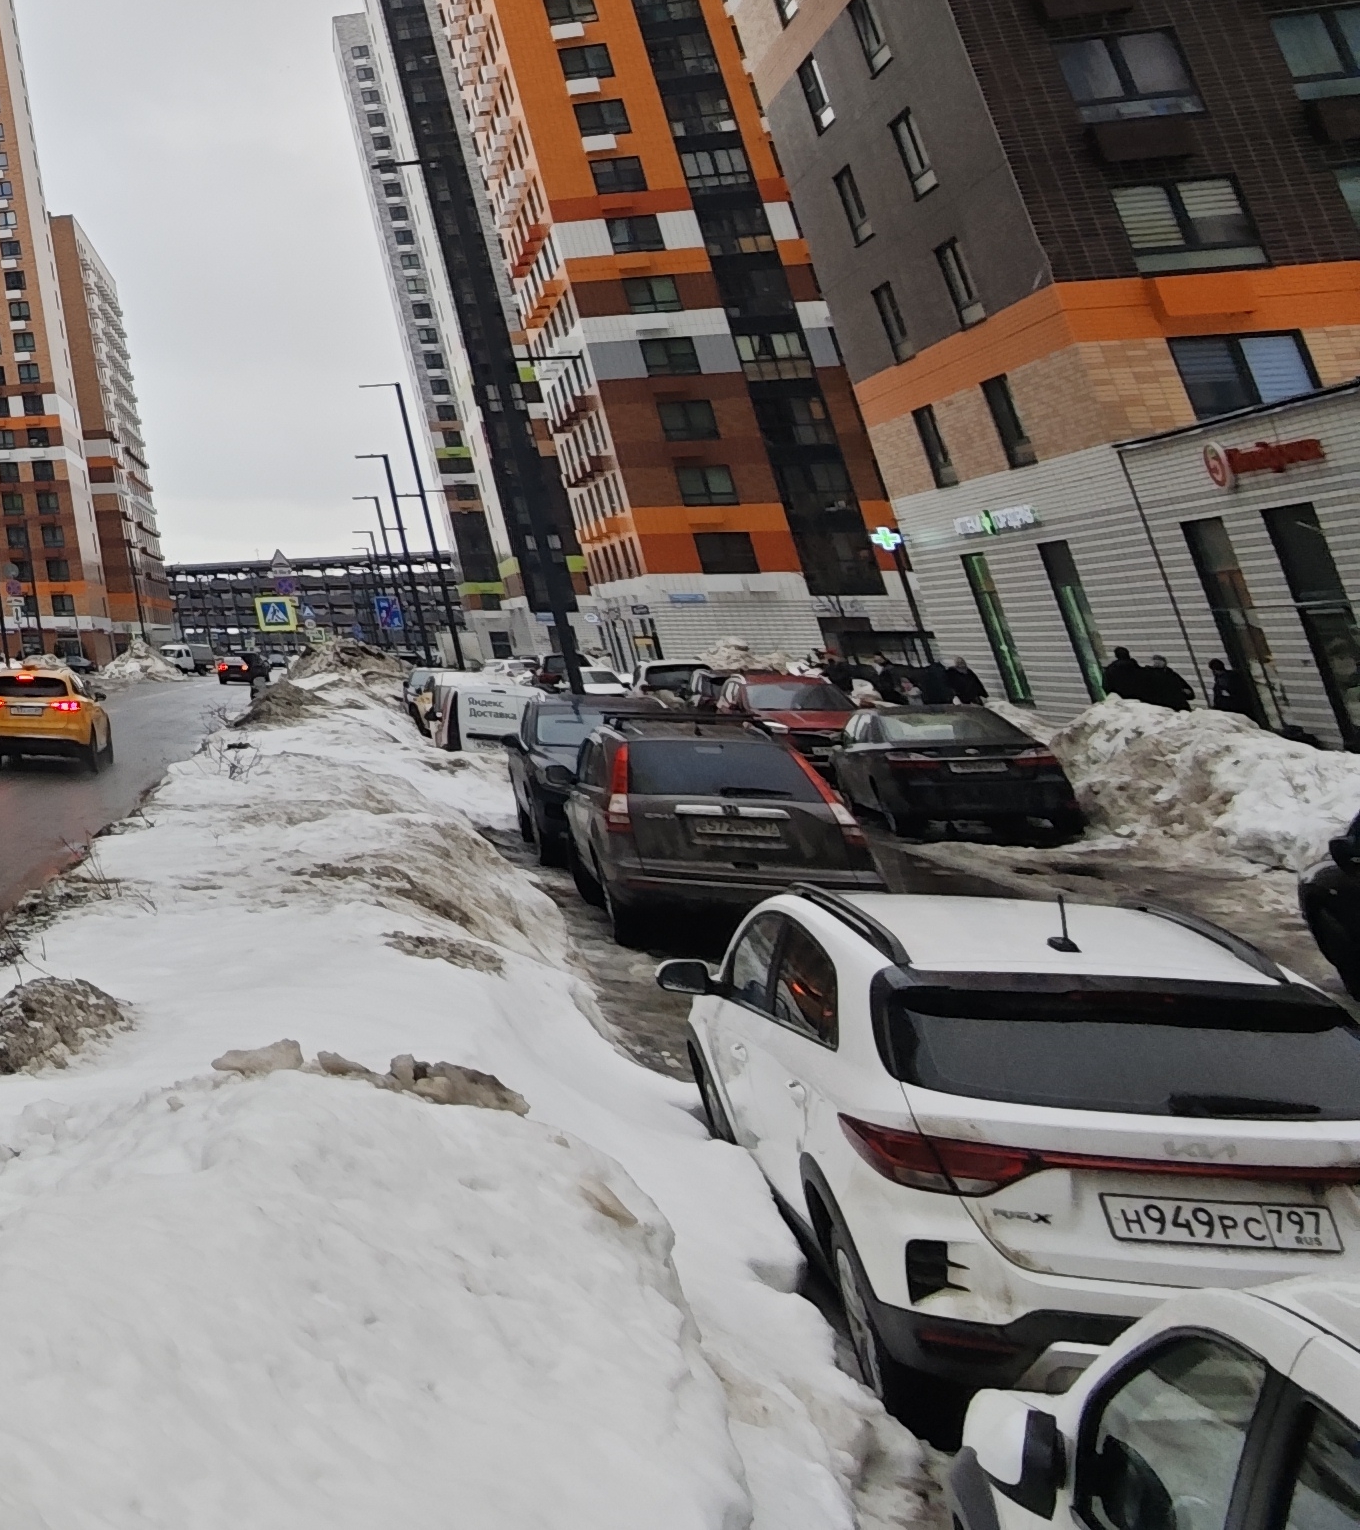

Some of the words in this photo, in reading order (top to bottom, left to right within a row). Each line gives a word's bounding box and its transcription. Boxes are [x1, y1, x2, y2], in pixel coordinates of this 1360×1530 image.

[468, 697, 504, 708] Яндекс
[469, 708, 517, 720] Доставка
[1267, 1209, 1321, 1235] 797
[1295, 1236, 1323, 1247] RUS
